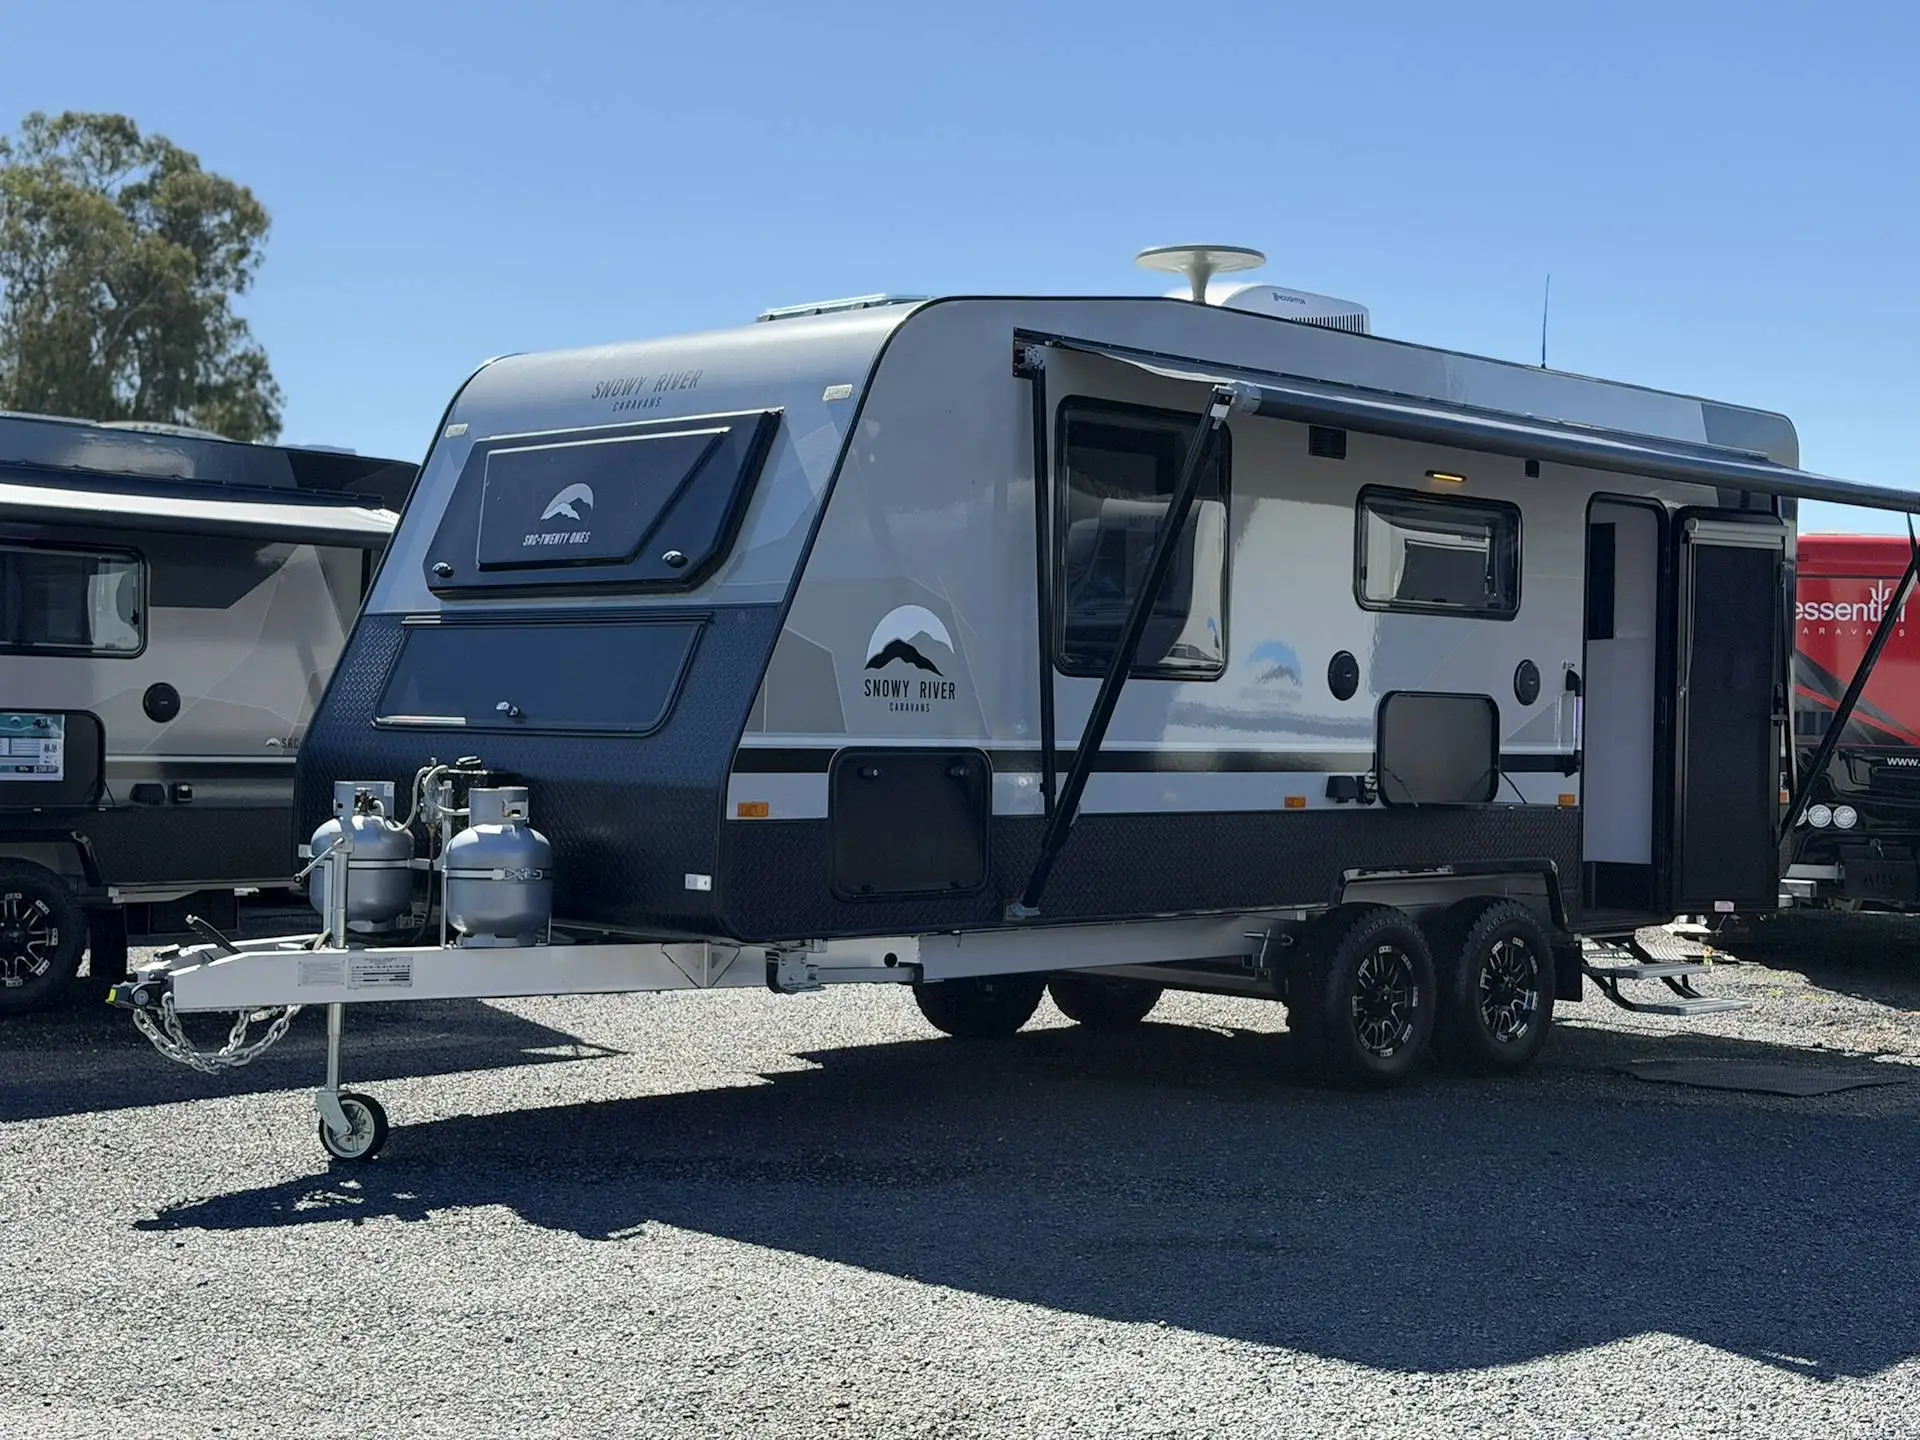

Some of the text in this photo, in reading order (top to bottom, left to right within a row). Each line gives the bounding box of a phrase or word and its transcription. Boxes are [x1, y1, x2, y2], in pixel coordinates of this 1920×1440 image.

[591, 369, 703, 399] SNOWY RIVER
[611, 396, 662, 412] CARAVANS
[864, 678, 956, 700] SNOWY RIVER
[889, 702, 930, 713] CARAVANS
